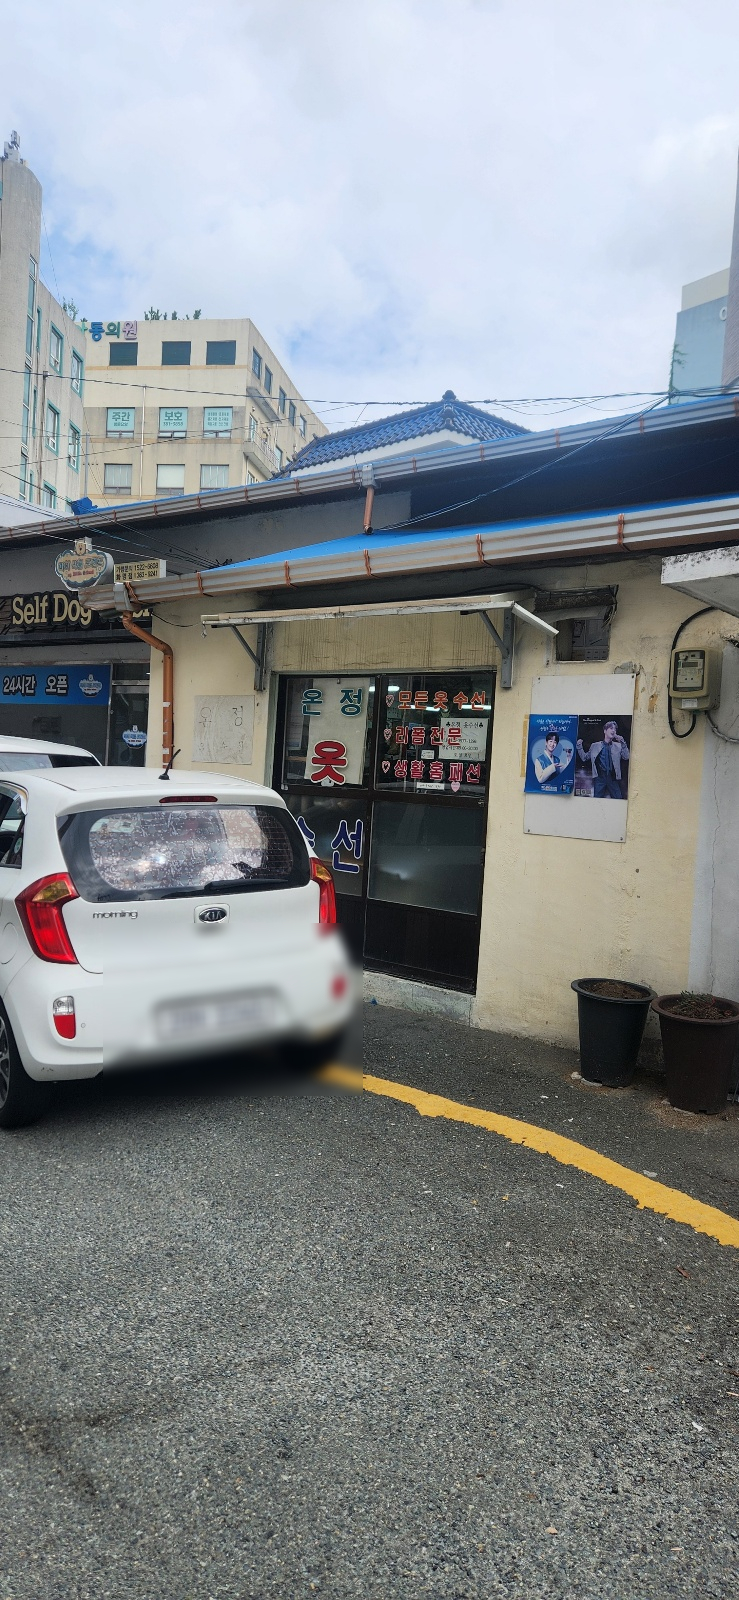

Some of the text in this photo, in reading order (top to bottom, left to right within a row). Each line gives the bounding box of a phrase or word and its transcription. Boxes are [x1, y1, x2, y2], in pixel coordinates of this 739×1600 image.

[111, 411, 183, 422] 주간 보호
[12, 593, 92, 625] Self Dog
[3, 675, 36, 694] 24시간
[45, 675, 69, 694] 오픈
[397, 690, 486, 711] 모든 옷 수선
[394, 726, 463, 746] 리폼 전문
[310, 740, 348, 785] 옷
[393, 759, 481, 783] 생활 홈 패션
[92, 909, 139, 921] morning
